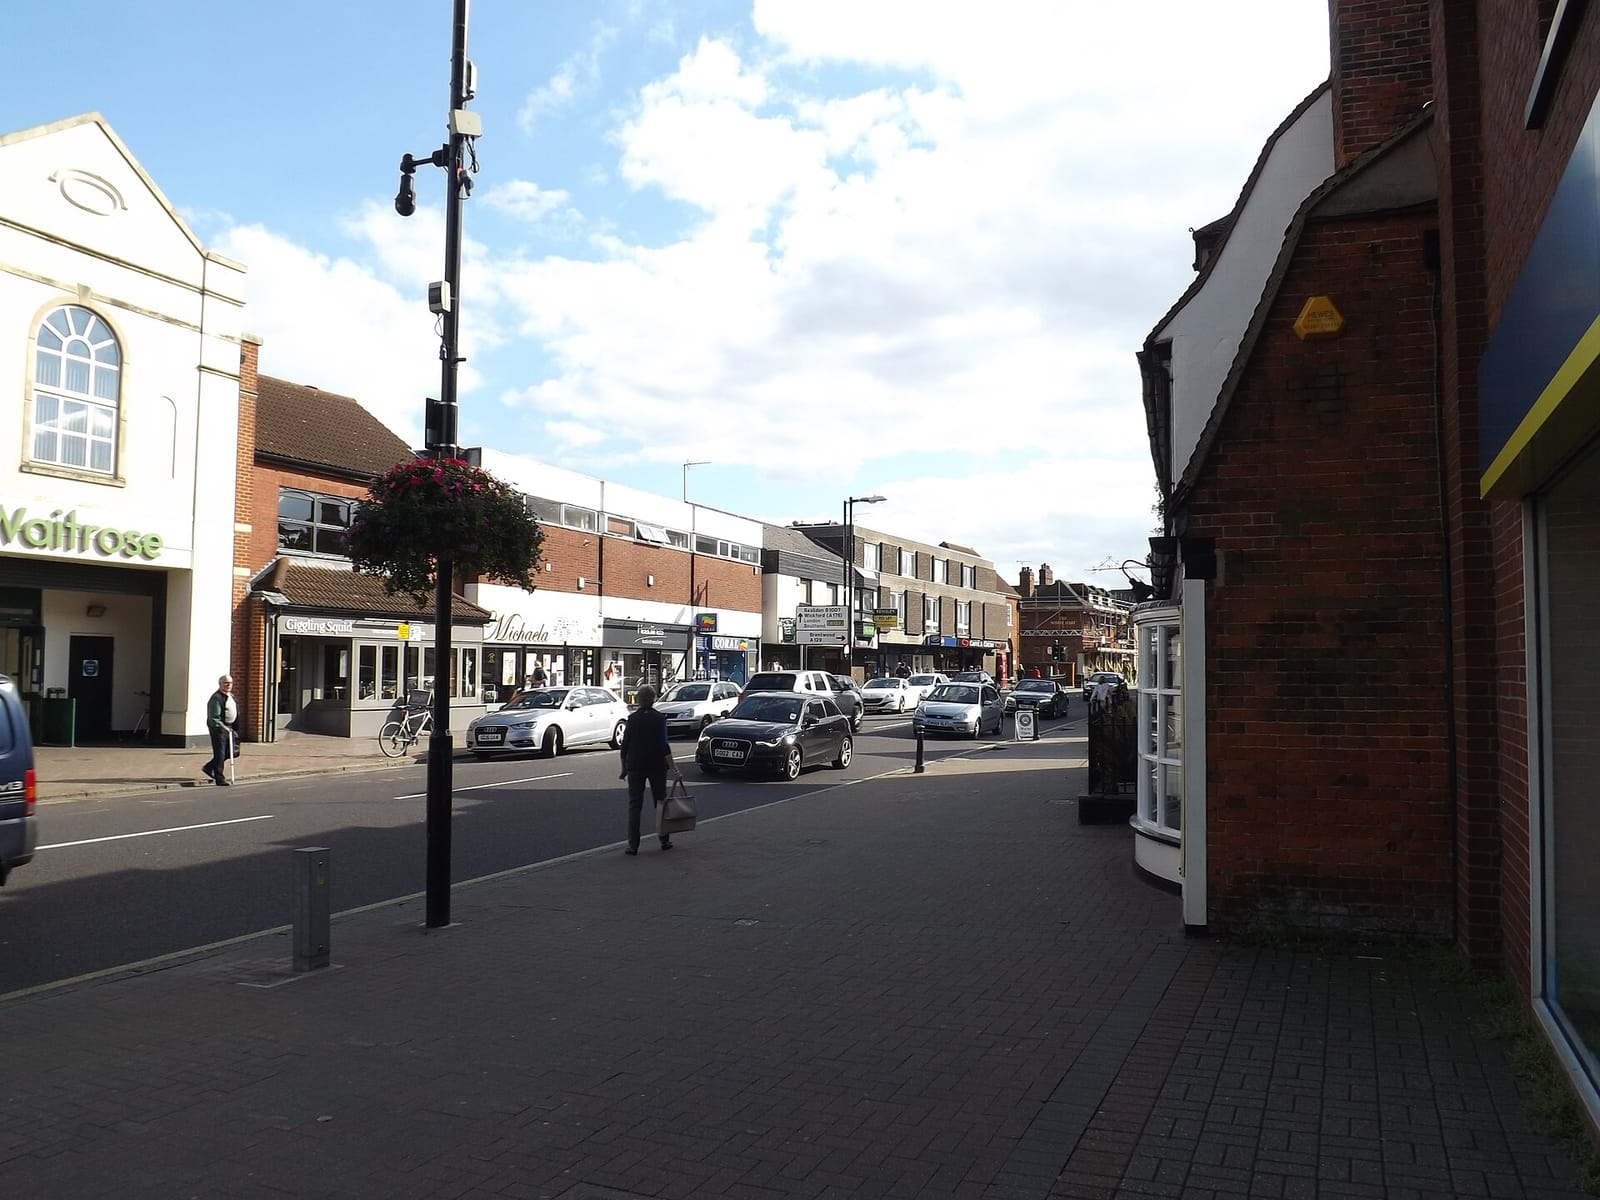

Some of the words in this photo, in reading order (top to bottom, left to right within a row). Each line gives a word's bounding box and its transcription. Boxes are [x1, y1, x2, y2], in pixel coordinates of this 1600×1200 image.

[285, 618, 326, 635] Giggling
[326, 622, 353, 635] Squid
[483, 613, 549, 642] Michaela
[714, 637, 738, 650] CORAL
